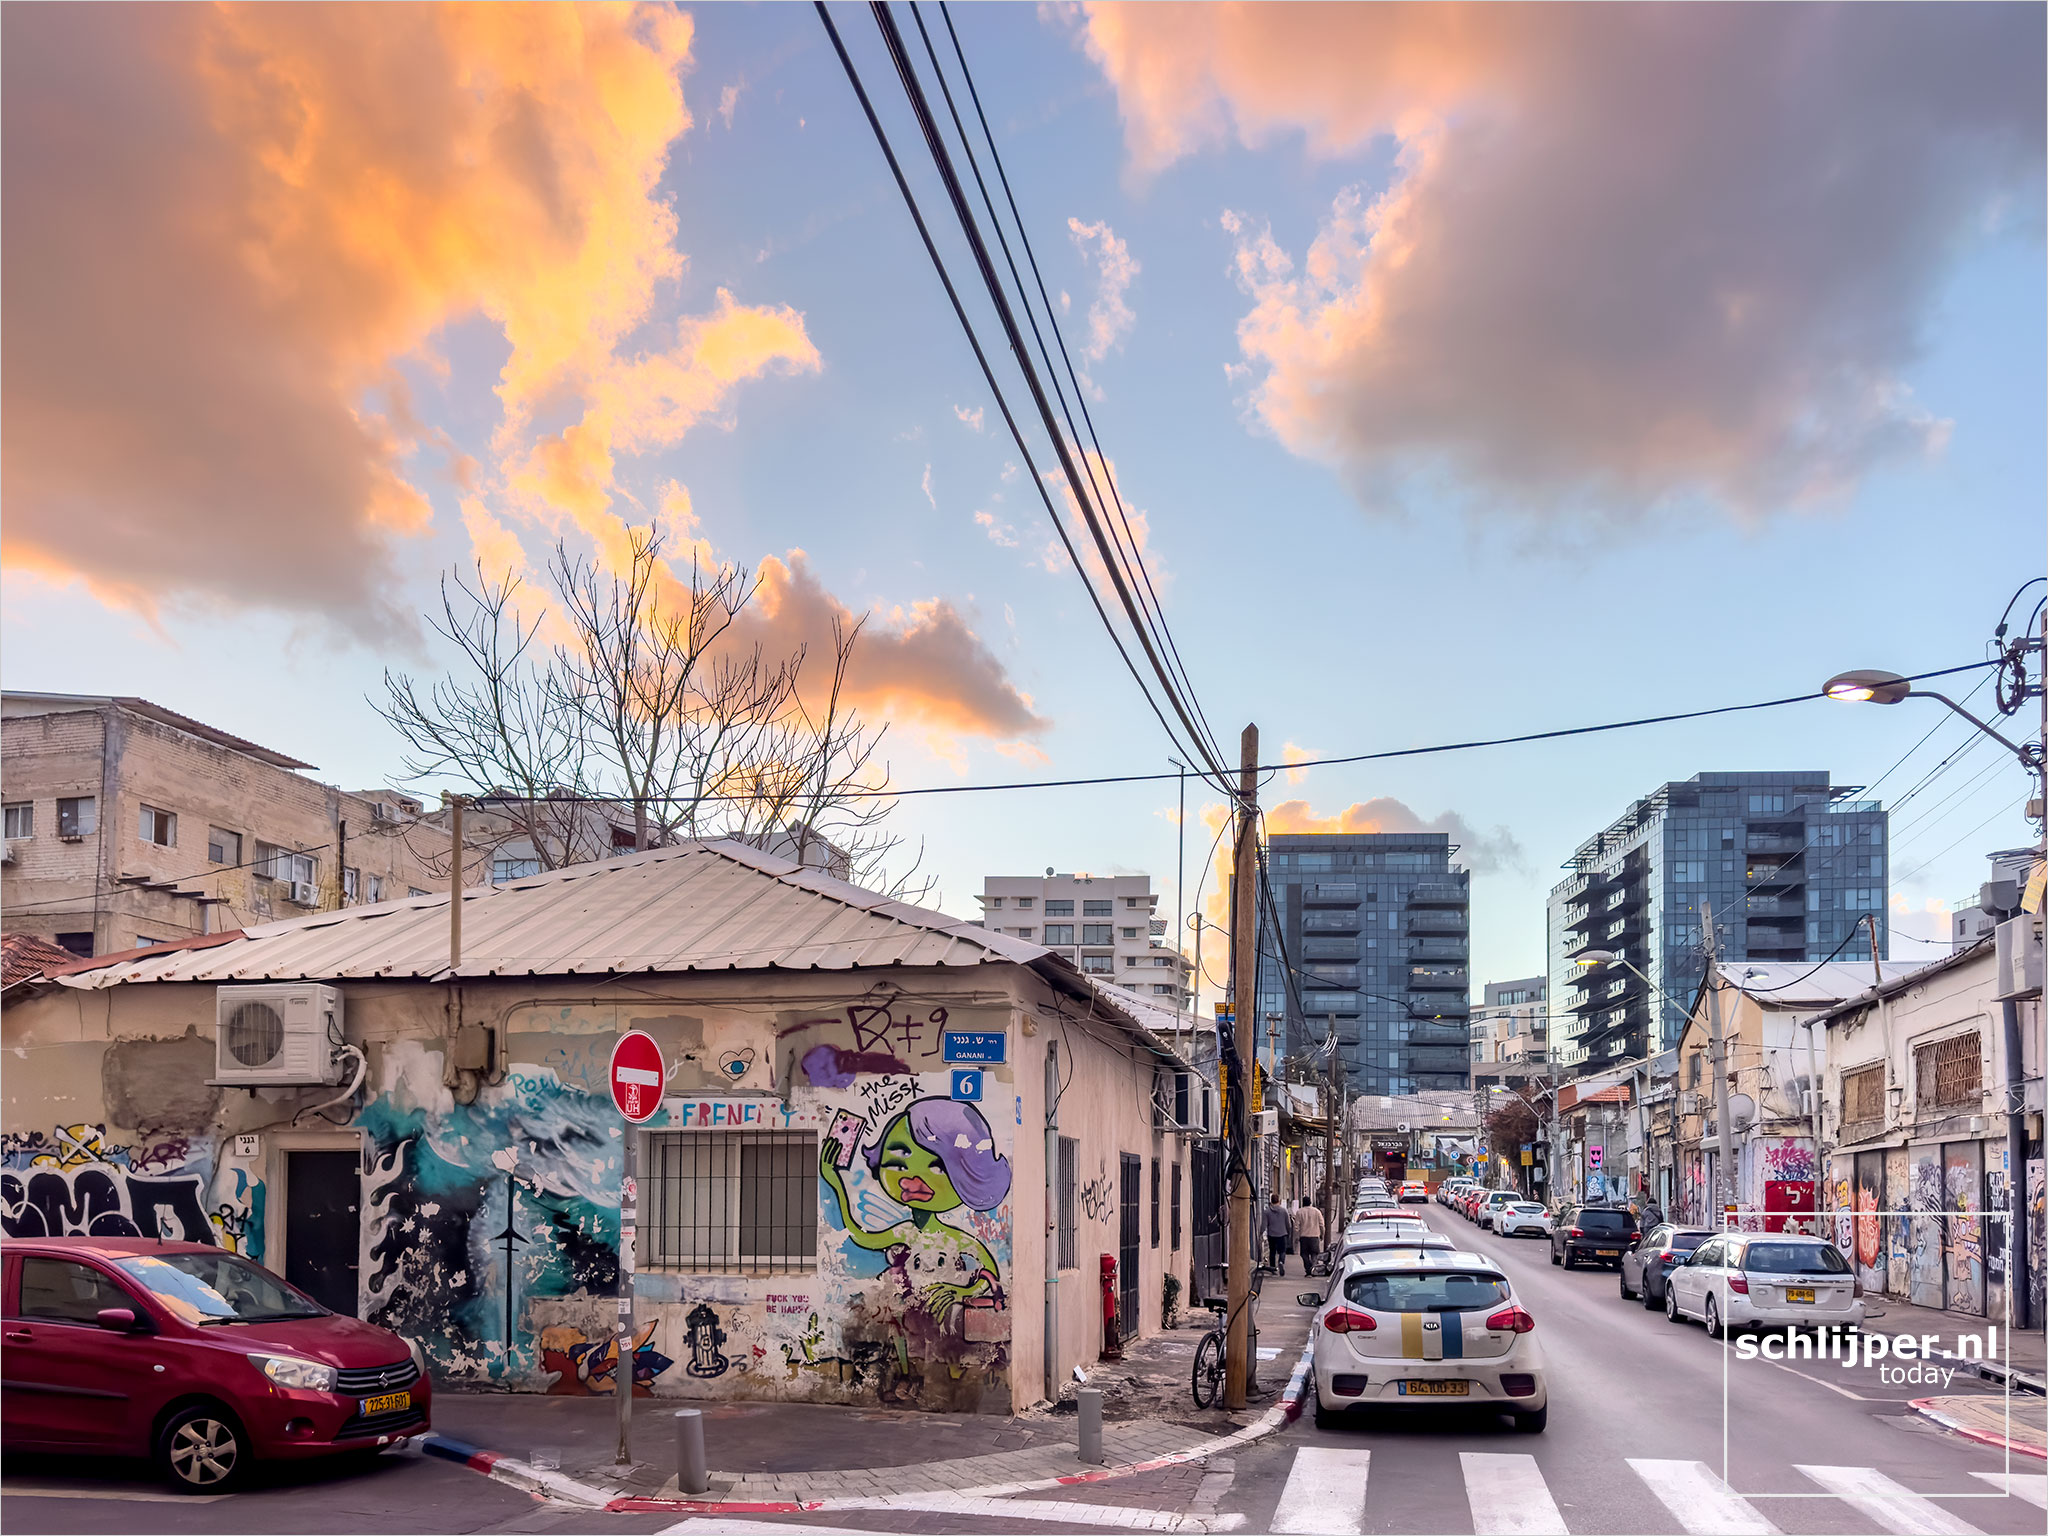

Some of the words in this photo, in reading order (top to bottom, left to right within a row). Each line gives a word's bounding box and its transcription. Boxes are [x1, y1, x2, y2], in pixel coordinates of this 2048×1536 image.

[956, 1051, 985, 1059] GANANI
[959, 1074, 974, 1095] 6
[240, 1136, 255, 1144] גנני
[245, 1146, 250, 1154] 6
[766, 1294, 788, 1303] FUCK
[792, 1294, 809, 1303] YOU
[766, 1306, 777, 1314] BE
[781, 1305, 809, 1314] HAPPY
[1425, 1322, 1438, 1330] KIA
